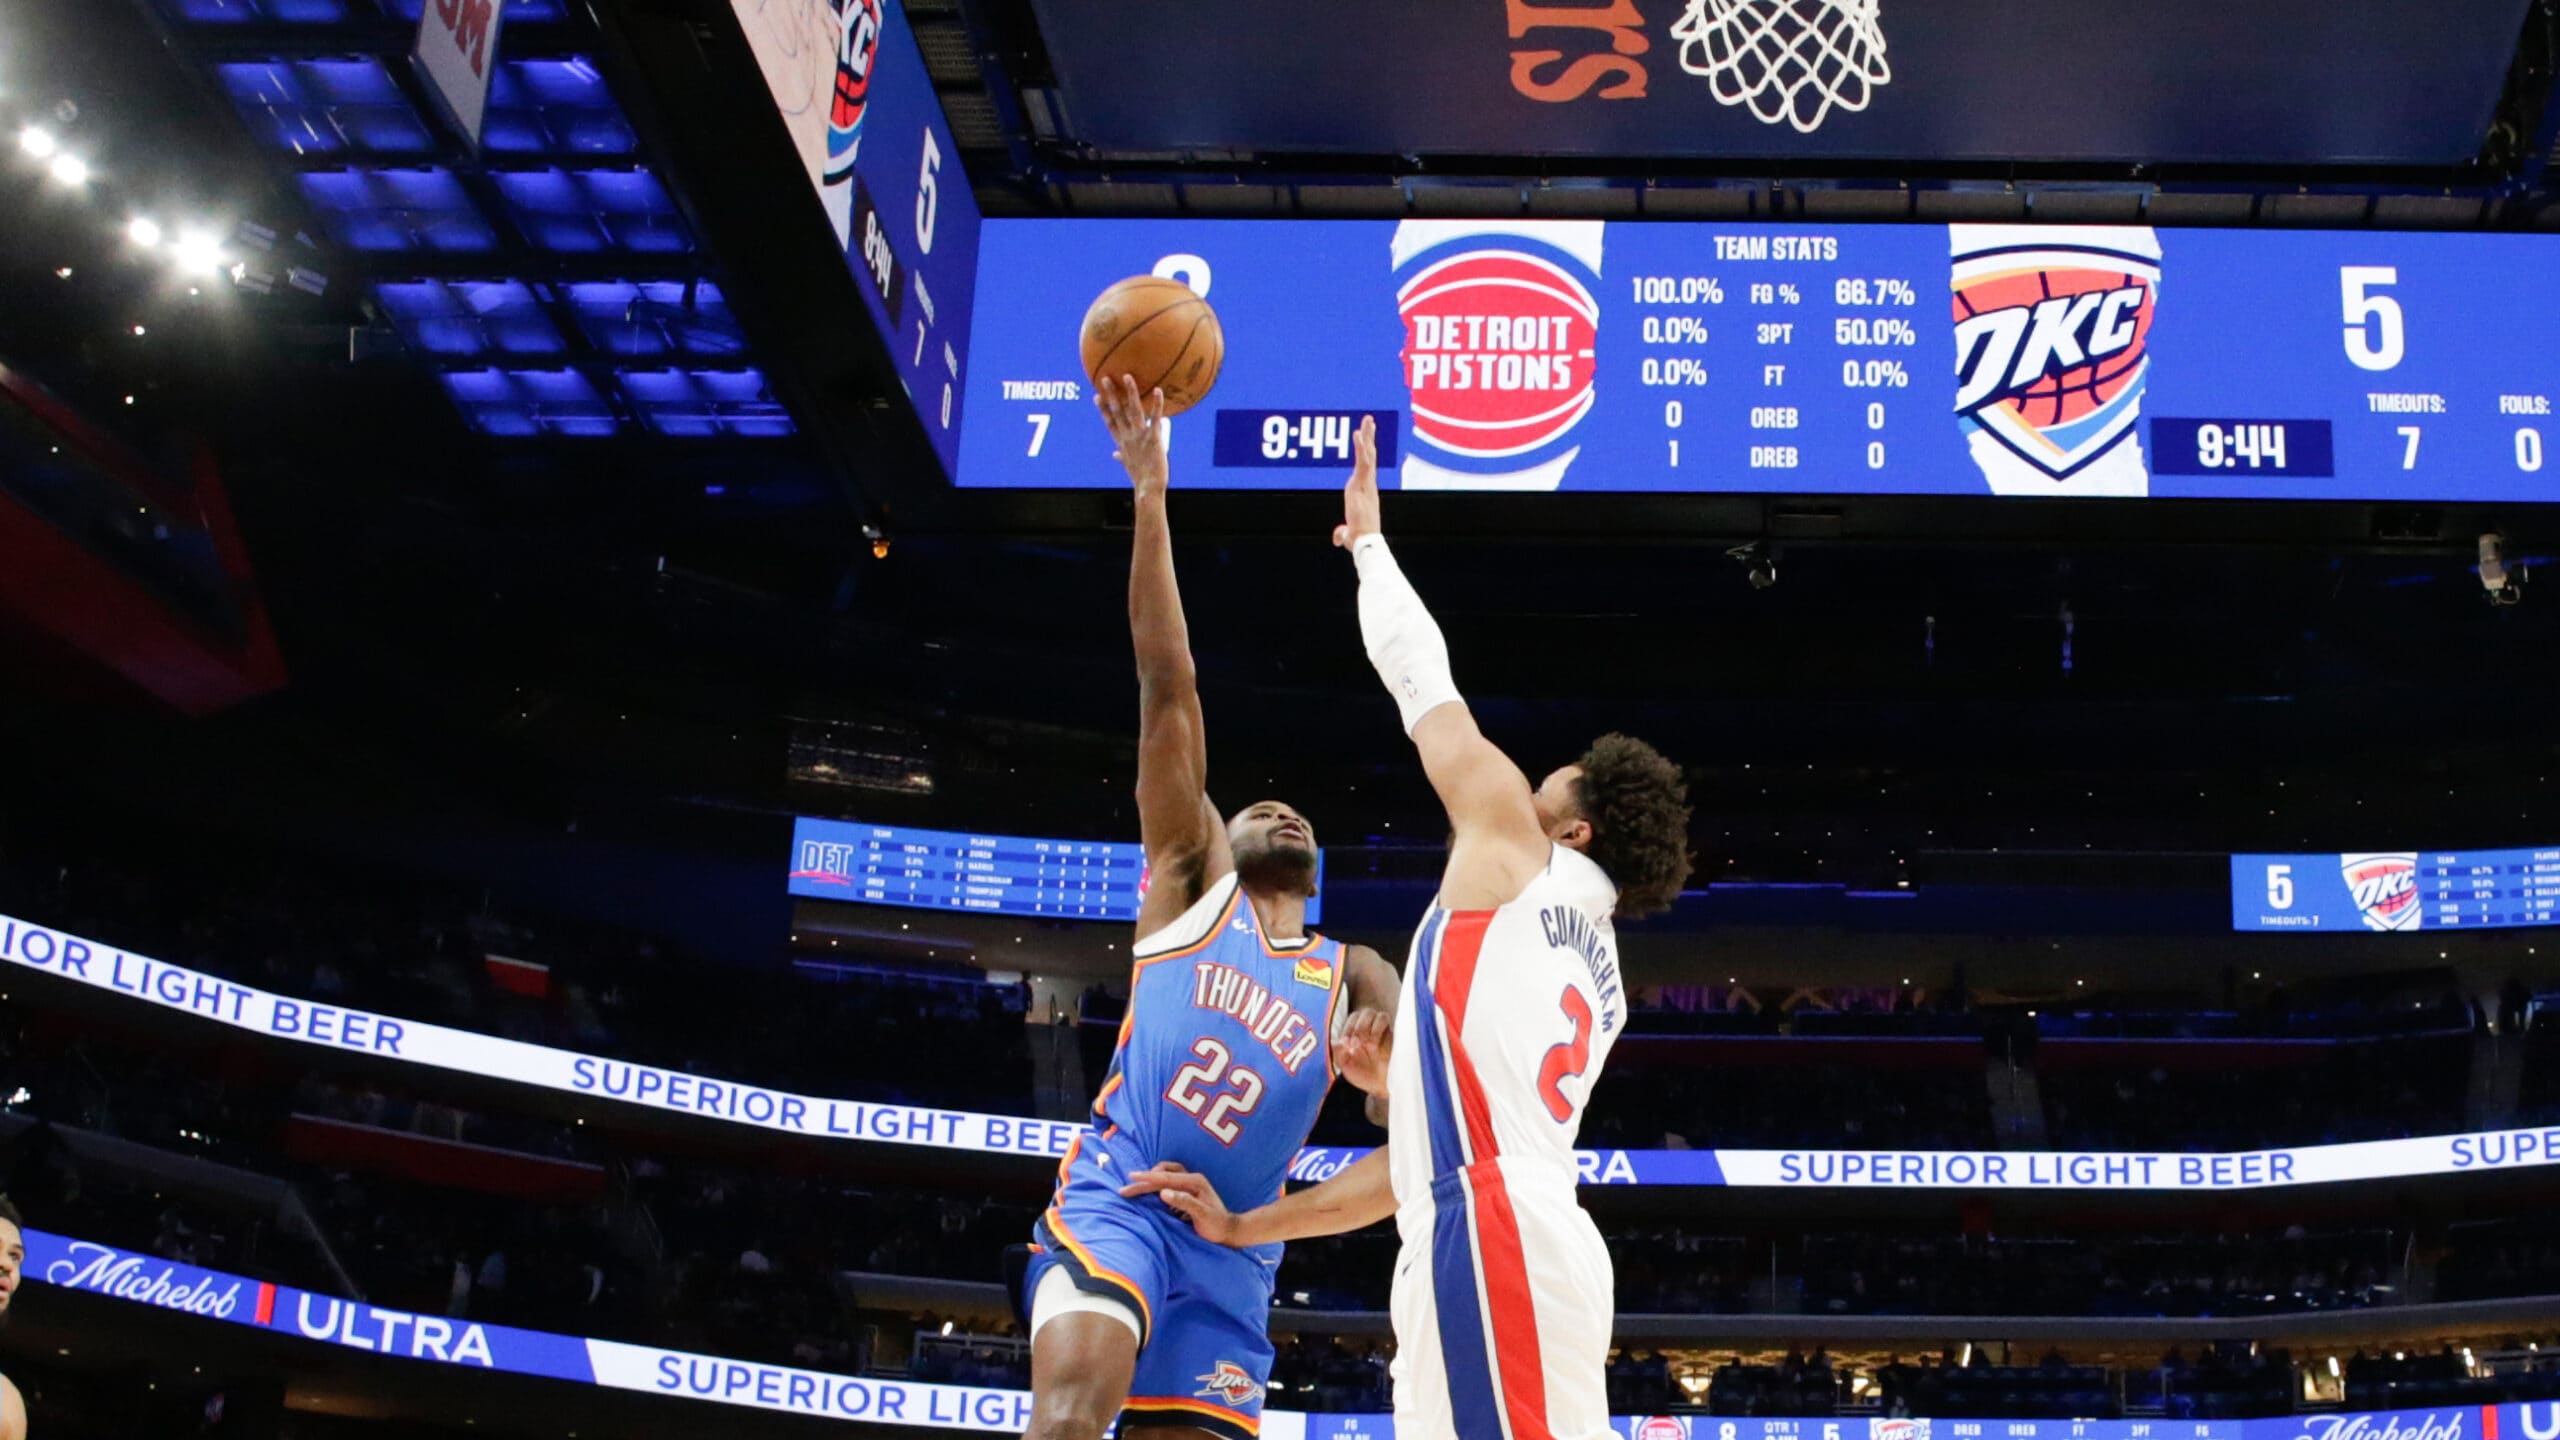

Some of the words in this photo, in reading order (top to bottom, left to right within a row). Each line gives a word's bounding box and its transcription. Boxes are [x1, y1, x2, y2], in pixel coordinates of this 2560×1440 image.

[916, 128, 940, 254] 5
[1714, 236, 1767, 259] TEAM
[1773, 237, 1837, 260] STATS
[1633, 277, 1723, 303] 100.0%
[1751, 284, 1773, 303] FG
[1779, 284, 1799, 304] %
[1836, 278, 1915, 305] 66.7%
[1412, 315, 1572, 350] DETROIT
[1643, 317, 1707, 343] 0.0%
[1758, 324, 1793, 343] 3PT
[1836, 318, 1915, 345] 50.0%
[2341, 266, 2404, 370] 5
[915, 320, 924, 365] 7
[1003, 381, 1079, 400] TIMEOUTS:
[1410, 354, 1572, 389] PISTONS
[1642, 359, 1706, 385] 0.0%
[1765, 366, 1785, 385] FT
[1844, 360, 1908, 387] 0.0%
[942, 383, 951, 428] 0
[1666, 401, 1682, 427] 0
[1751, 407, 1798, 428] OREB
[1868, 403, 1884, 429] 0
[2367, 393, 2445, 412] TIMEOUTS:
[2500, 395, 2550, 414] FOULS:
[1028, 414, 1050, 456] 7
[1262, 416, 1350, 458] 9:44
[1669, 440, 1678, 466] 1
[1751, 447, 1798, 467] DREB
[1868, 442, 1884, 468] 0
[2198, 424, 2285, 467] 9:44
[2398, 427, 2420, 469] 7
[2516, 428, 2542, 471] 0
[801, 840, 853, 876] DET
[2268, 865, 2293, 909] 5
[2262, 917, 2310, 925] TIMEOUTS:
[2313, 916, 2318, 925] 7
[1539, 905, 1618, 1034] CUNNINGHAM
[112, 950, 254, 1024] LIGHT
[271, 1000, 405, 1056] BEER
[1194, 962, 1320, 1076] THUNDER
[1537, 984, 1593, 1124] 2
[572, 1058, 808, 1132] SUPERIOR
[827, 1101, 966, 1146] LIGHT
[984, 1119, 1098, 1154] BEE
[1166, 1037, 1264, 1149] 22
[1778, 1153, 2011, 1184] SUPERIOR
[2028, 1154, 2162, 1186] LIGHT
[2178, 1152, 2296, 1186] BEER
[46, 1240, 242, 1319] Michelob
[297, 1292, 494, 1367] ULTRA
[656, 1356, 906, 1419] SUPERIOR
